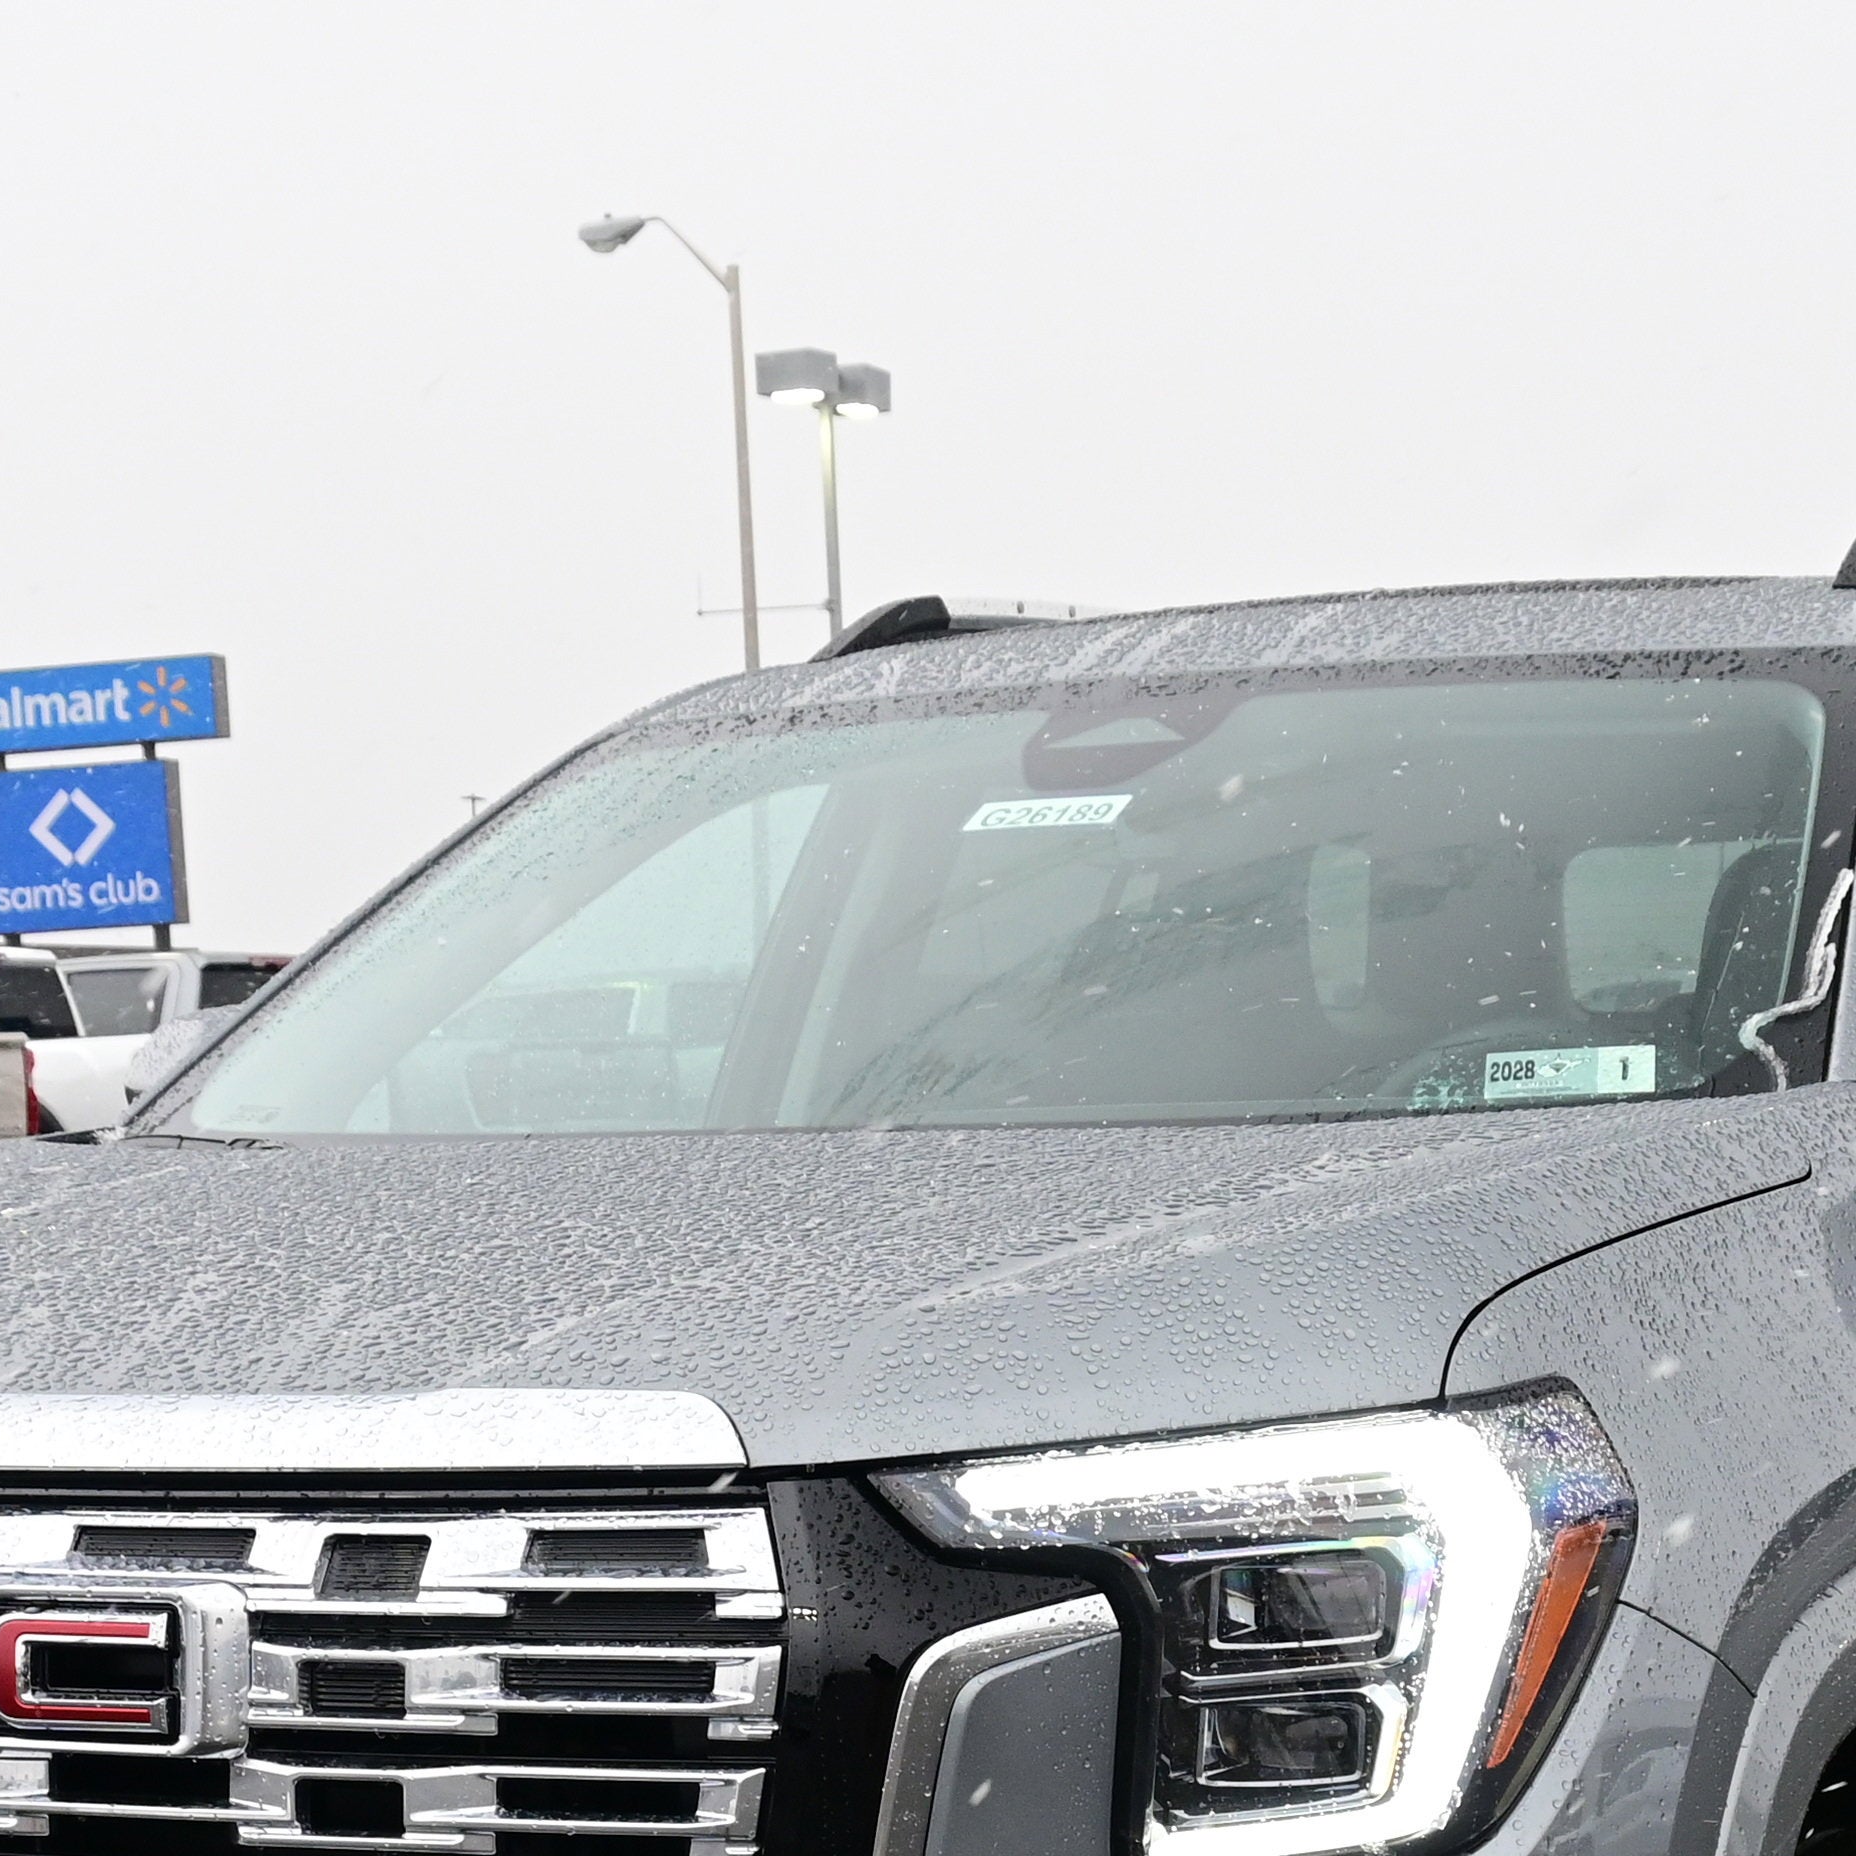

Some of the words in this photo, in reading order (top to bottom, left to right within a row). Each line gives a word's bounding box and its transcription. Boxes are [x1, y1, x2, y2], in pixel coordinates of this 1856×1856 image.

[981, 803, 1114, 827] G26189
[89, 871, 161, 905] club
[1490, 1060, 1535, 1082] 2028
